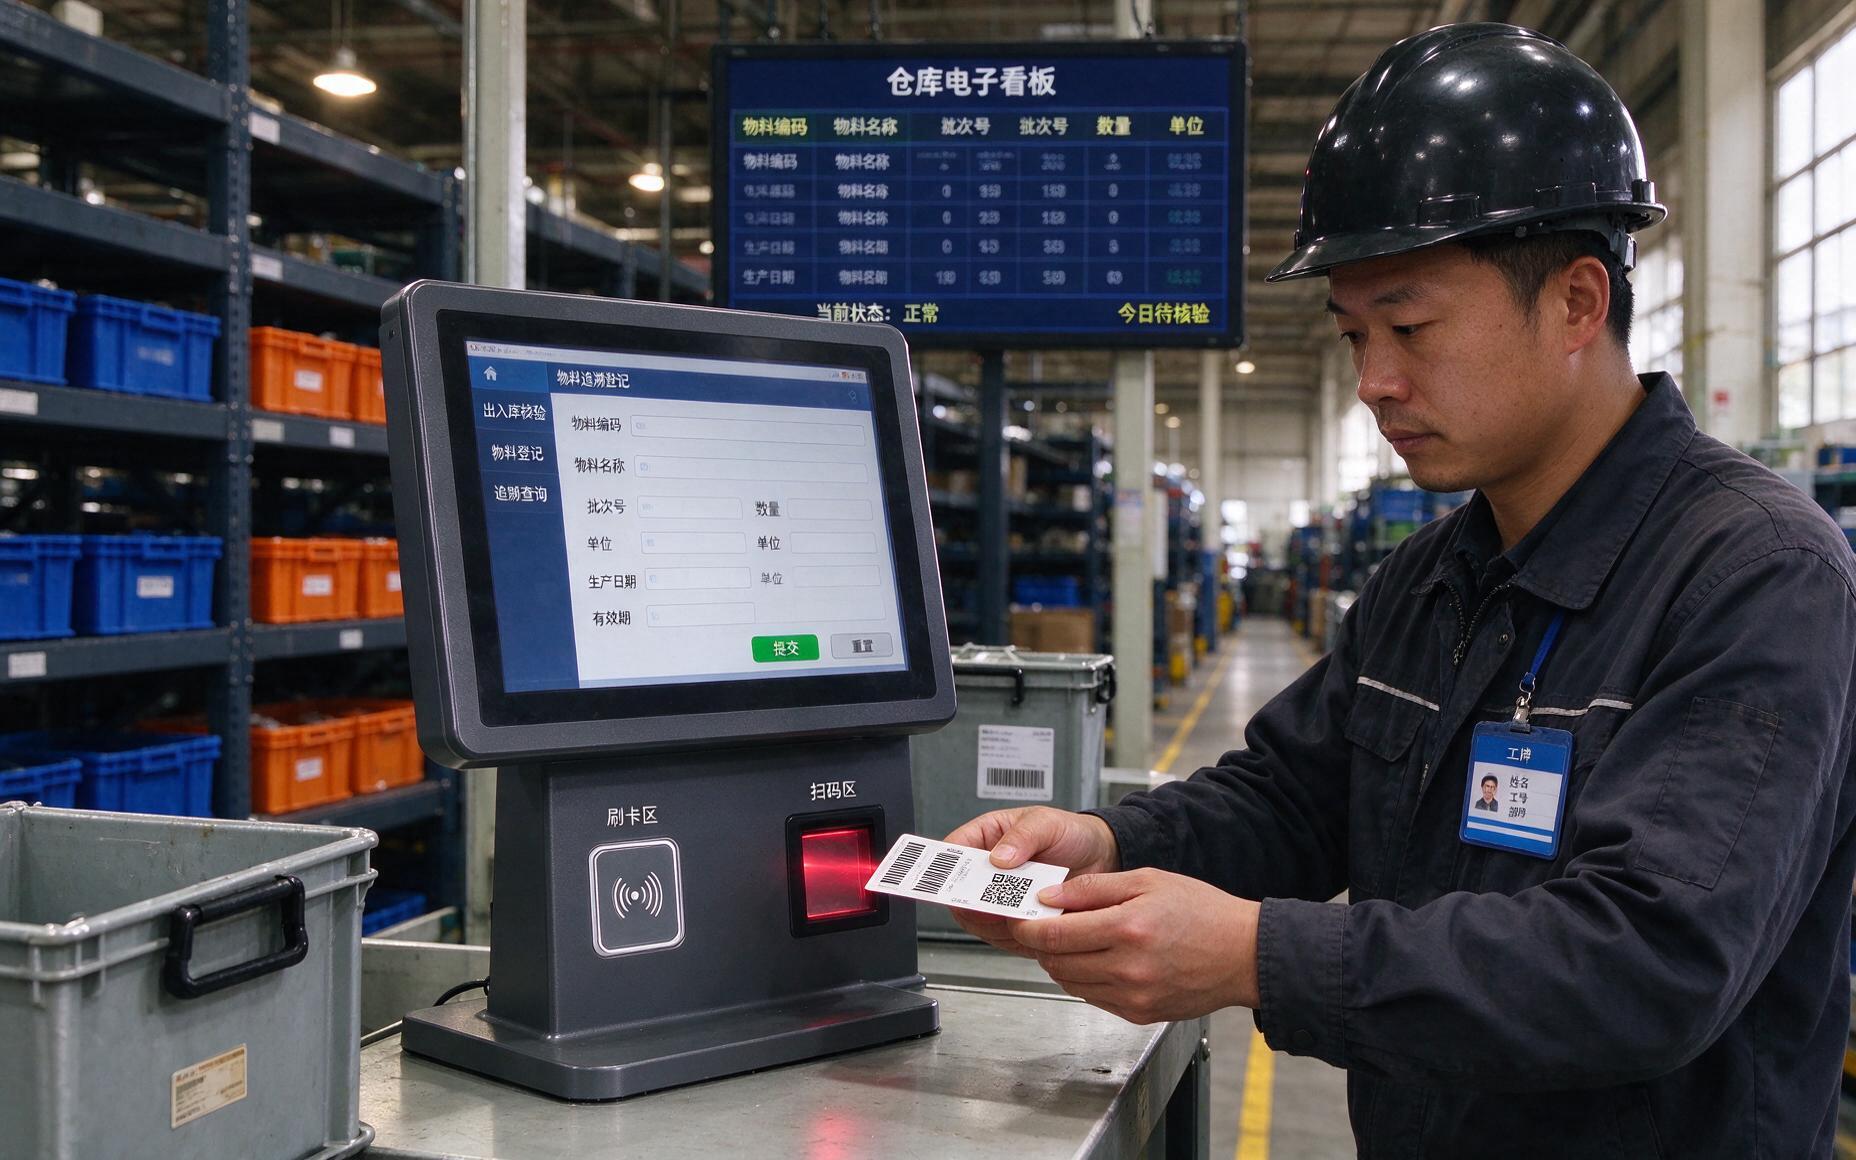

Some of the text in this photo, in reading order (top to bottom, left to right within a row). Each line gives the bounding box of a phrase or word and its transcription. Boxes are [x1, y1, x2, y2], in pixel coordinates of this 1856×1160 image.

[887, 66, 1057, 98] 仓库电子看板
[743, 116, 1204, 137] 物料编码 物料名称 批次号 批次号 数量 单位
[903, 303, 939, 323] 正常
[1118, 303, 1210, 324] 今日待核验
[572, 416, 622, 432] 物料编码
[492, 444, 544, 462] 物料登记
[574, 457, 626, 474] 物料名称
[587, 498, 626, 514] 批次号
[587, 536, 612, 551] 单位
[757, 536, 781, 551] 单位
[588, 574, 637, 589] 生产日期
[592, 610, 631, 627] 有效期
[773, 640, 800, 657] 提交
[810, 780, 857, 801] 扫码区
[607, 805, 659, 827] 刷卡区
